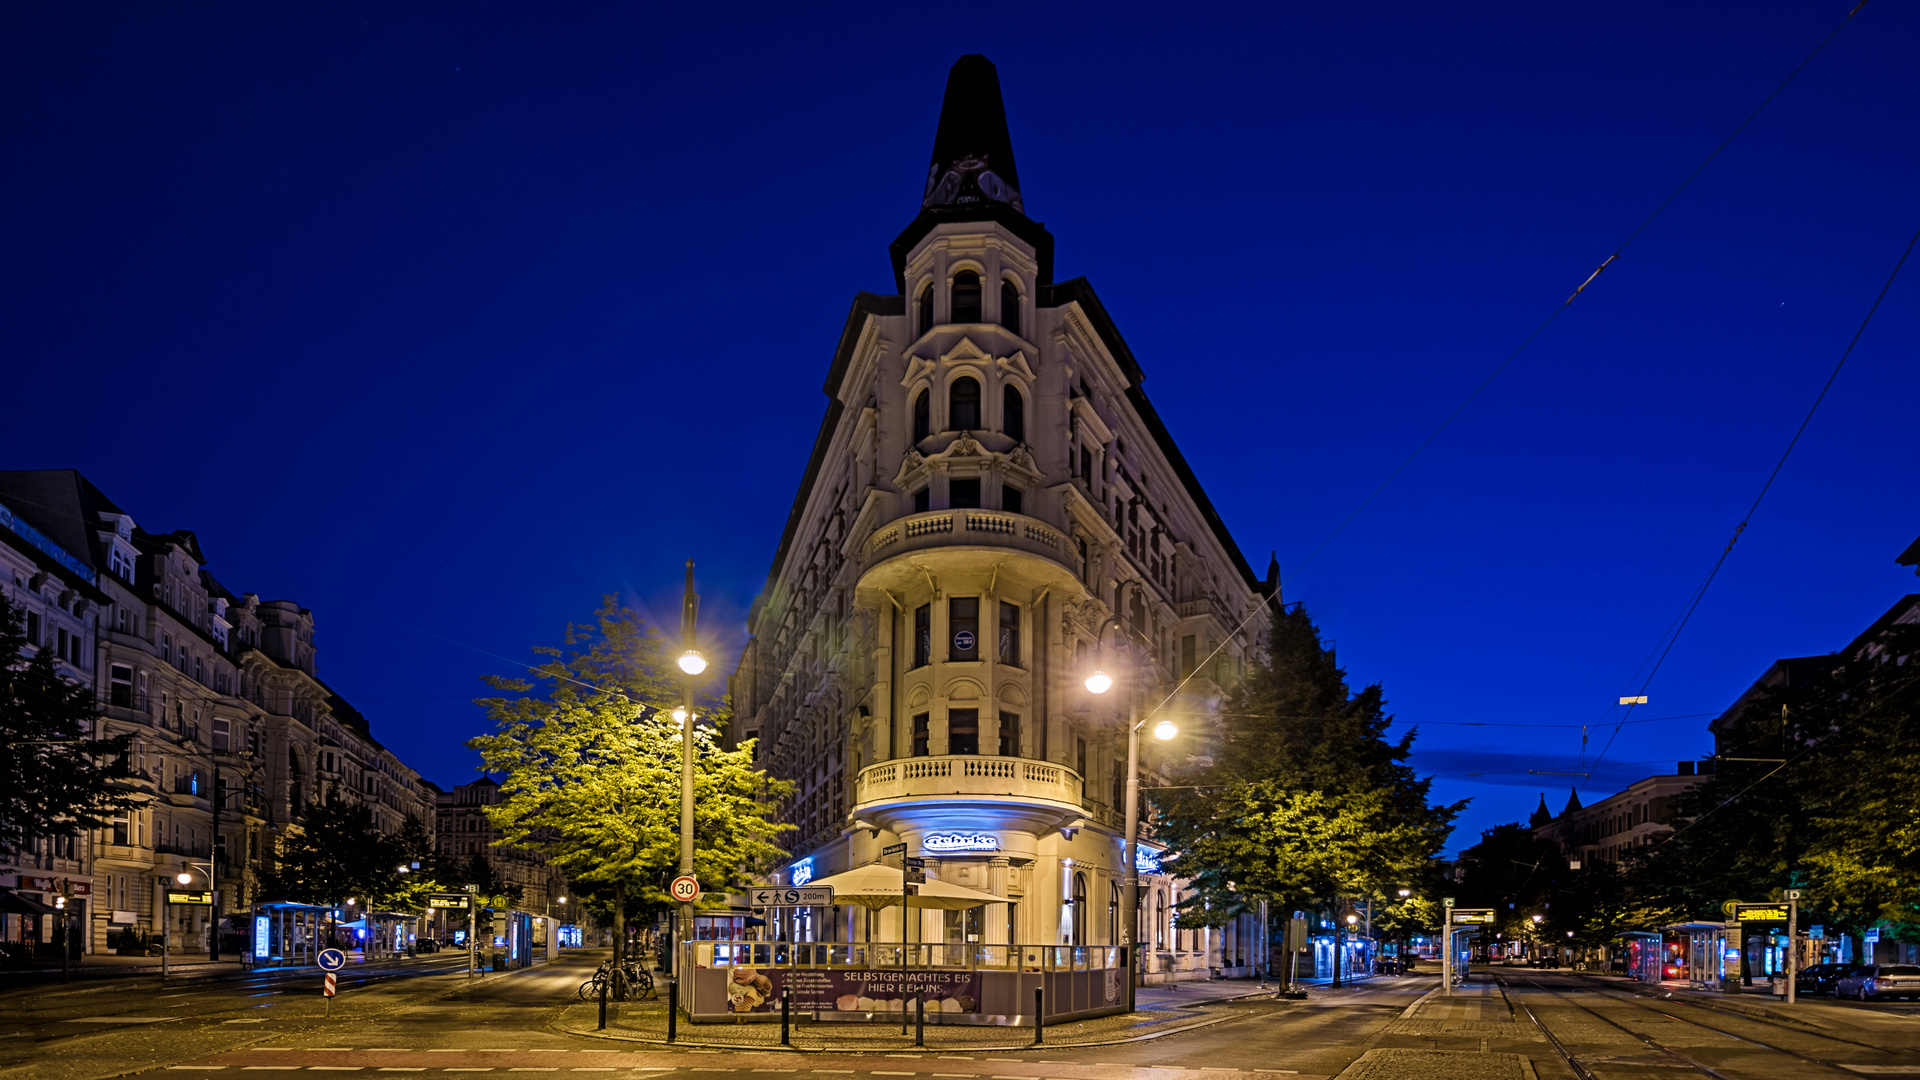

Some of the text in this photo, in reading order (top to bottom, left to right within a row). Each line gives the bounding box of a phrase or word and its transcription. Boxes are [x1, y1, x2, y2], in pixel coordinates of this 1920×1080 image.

[923, 834, 997, 850] Gehrke
[160, 877, 169, 885] A
[677, 883, 693, 895] 30
[1789, 891, 1800, 899] D
[496, 897, 503, 906] H
[954, 974, 971, 983] EIS
[868, 983, 895, 992] HIER
